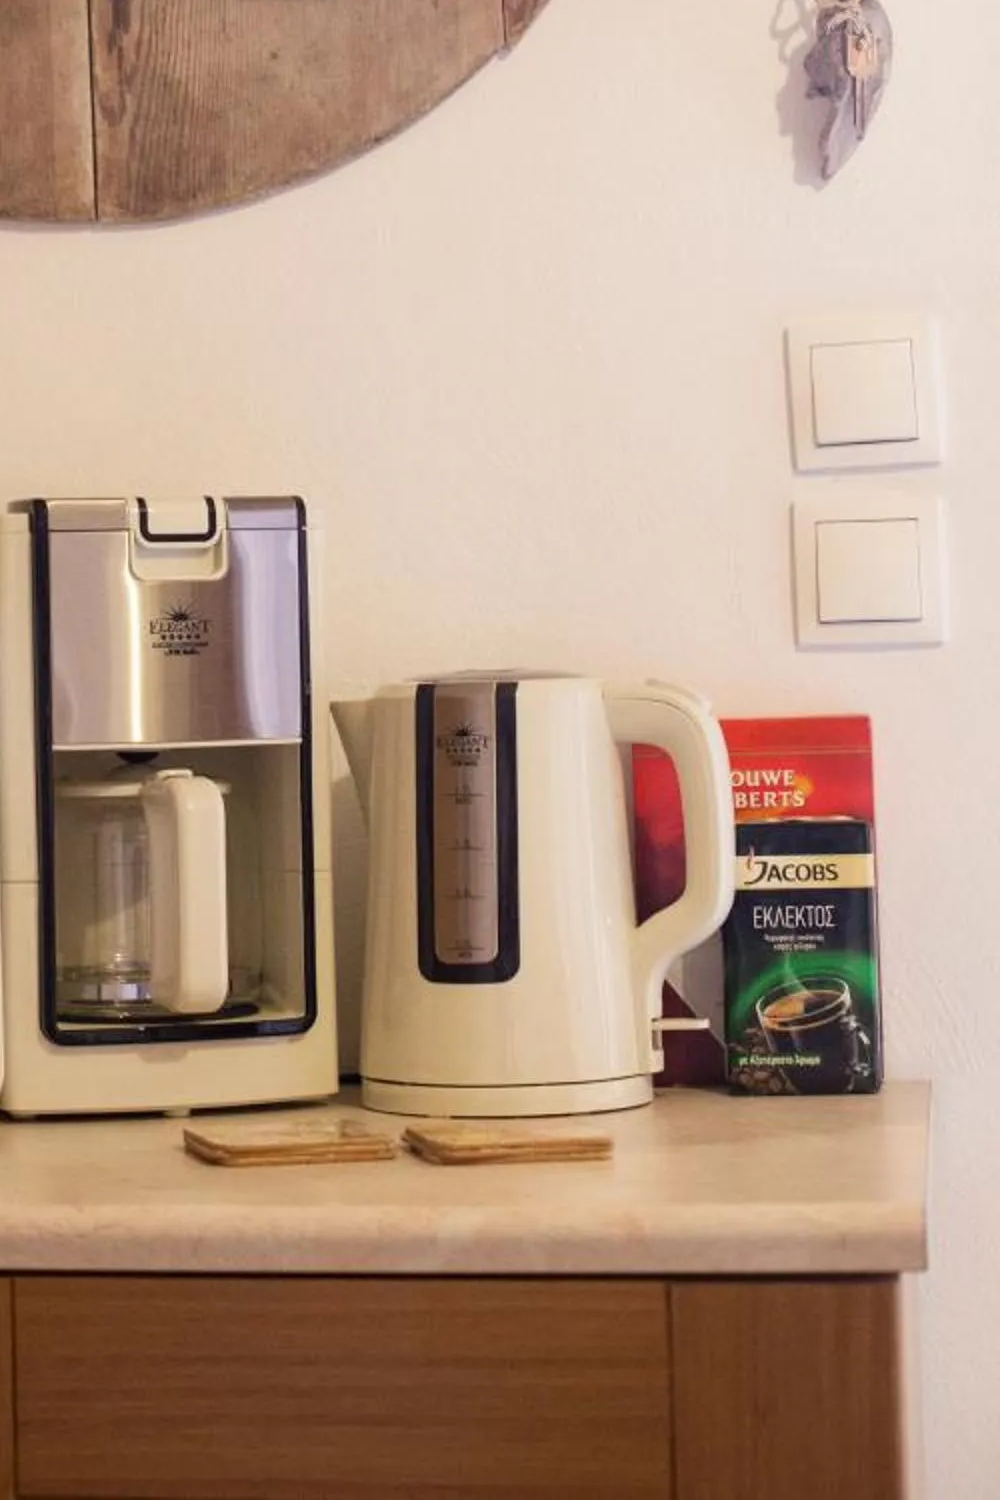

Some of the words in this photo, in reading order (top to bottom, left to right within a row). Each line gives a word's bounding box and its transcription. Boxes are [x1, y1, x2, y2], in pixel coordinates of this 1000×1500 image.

[730, 770, 795, 787] OUWE
[735, 790, 806, 808] BERTS
[743, 861, 839, 885] JACOBS
